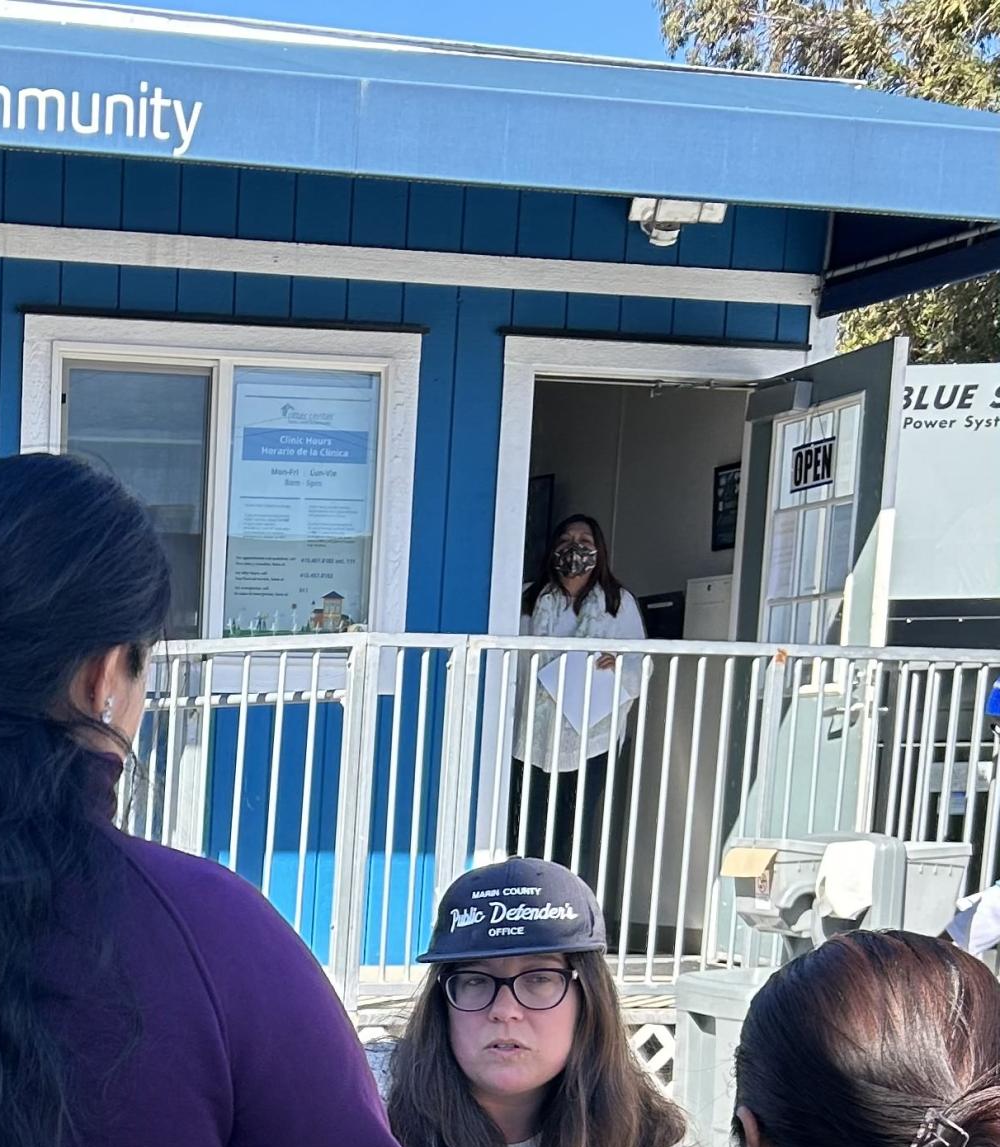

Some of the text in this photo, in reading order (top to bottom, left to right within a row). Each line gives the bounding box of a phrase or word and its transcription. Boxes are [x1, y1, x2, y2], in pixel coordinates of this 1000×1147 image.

[903, 417, 957, 430] Power
[279, 435, 332, 446] Clinic Hours
[261, 446, 295, 456] Horario
[296, 447, 308, 456] de
[309, 448, 318, 457] la
[794, 443, 833, 487] OPEN
[472, 887, 542, 899] MARIN COUNTY
[450, 901, 578, 933] Public Defender's
[488, 926, 525, 937] OFFICE
